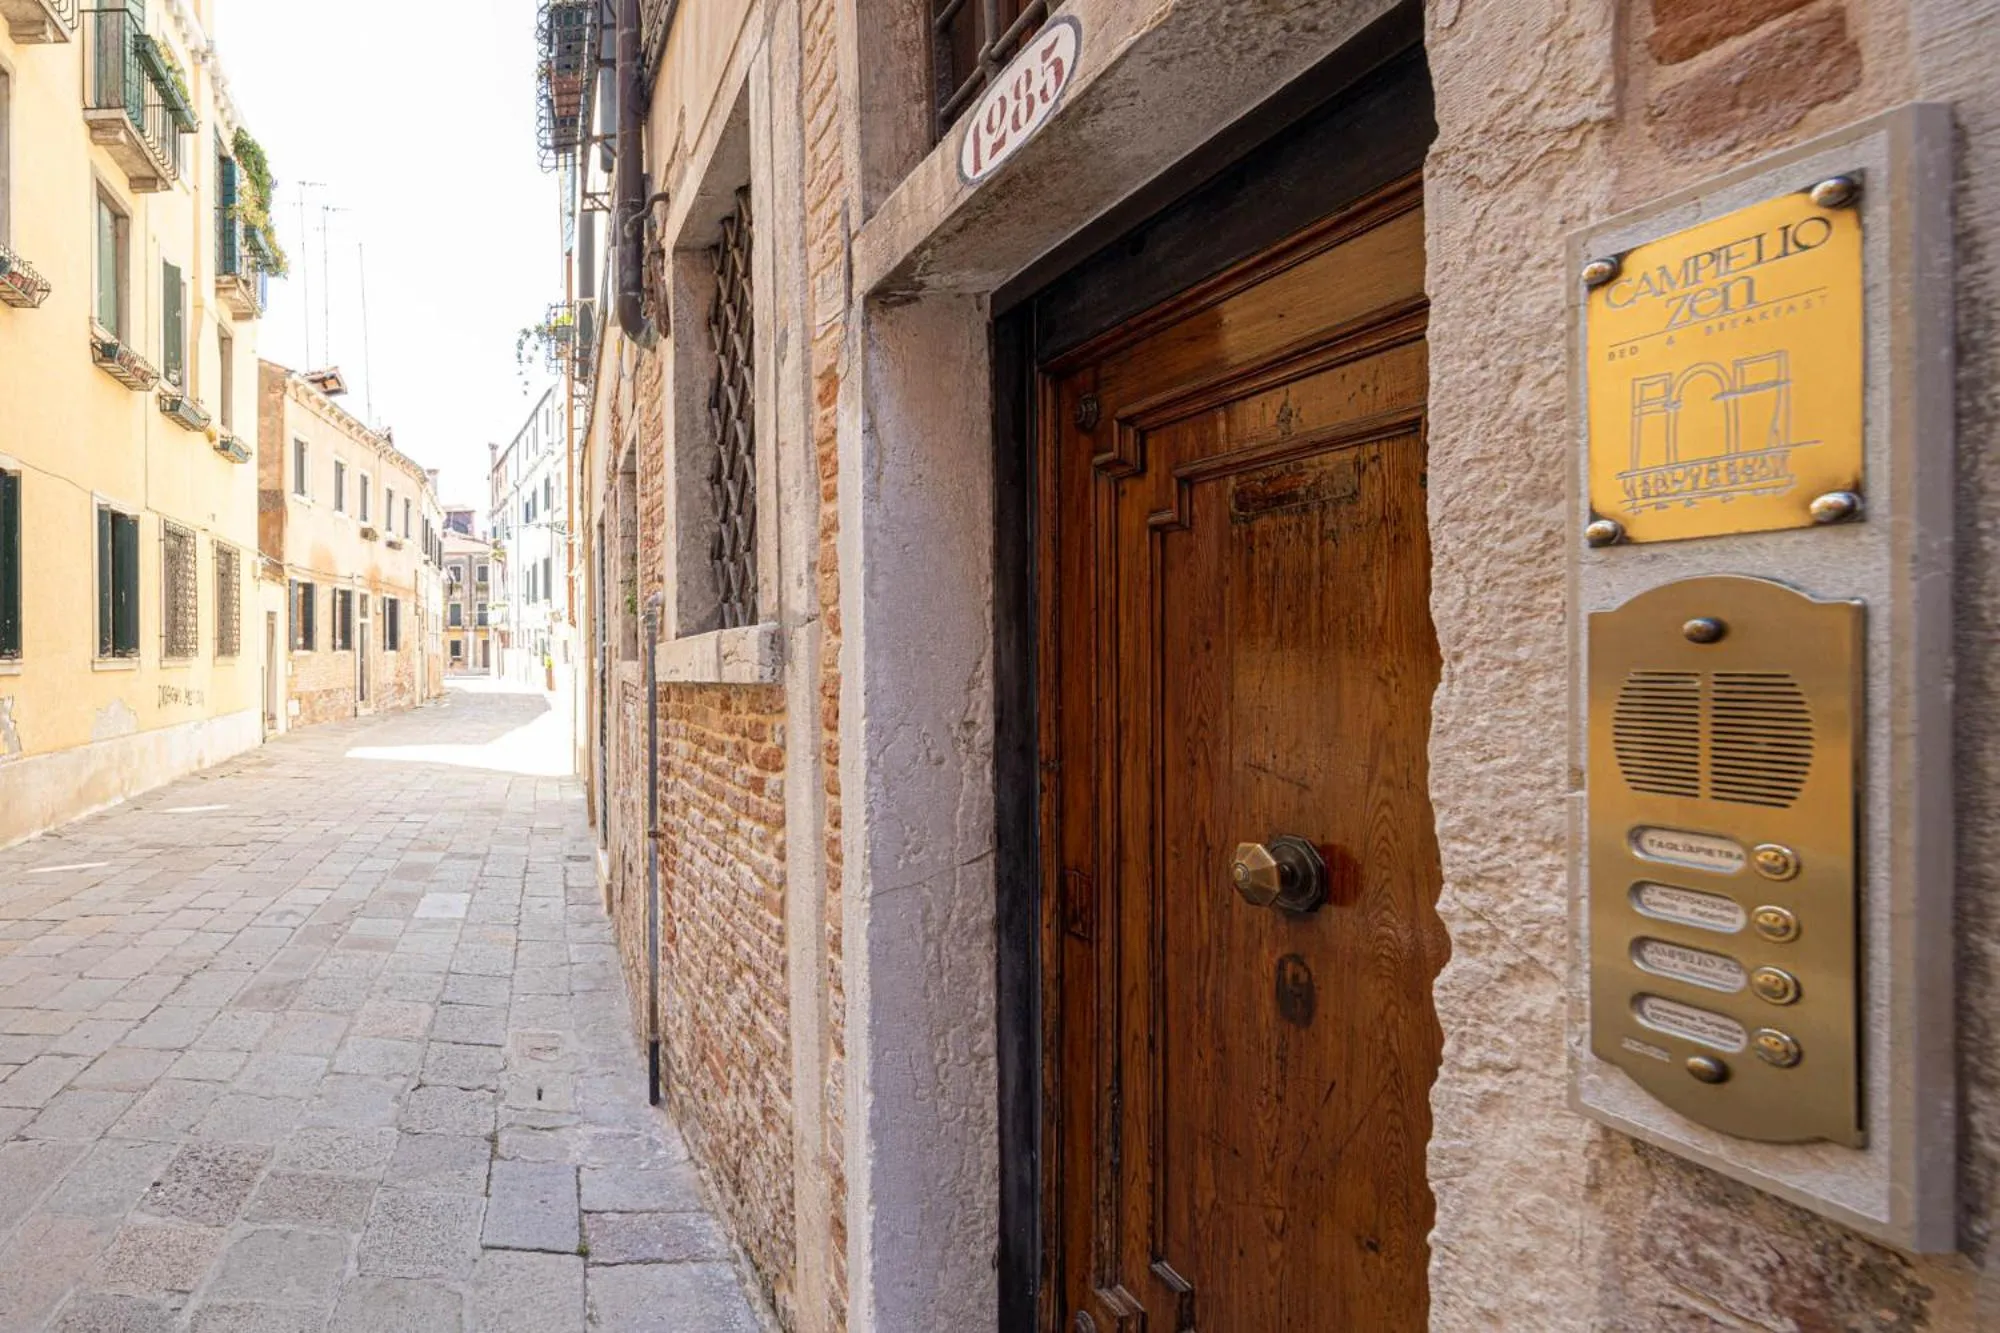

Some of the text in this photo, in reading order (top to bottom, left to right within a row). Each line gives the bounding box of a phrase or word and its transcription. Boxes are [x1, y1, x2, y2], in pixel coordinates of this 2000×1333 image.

[972, 35, 1065, 177] 1985
[1605, 216, 1833, 311] CAMPIELLO
[1607, 345, 1640, 362] BED
[1703, 294, 1828, 336] BREAKFAST
